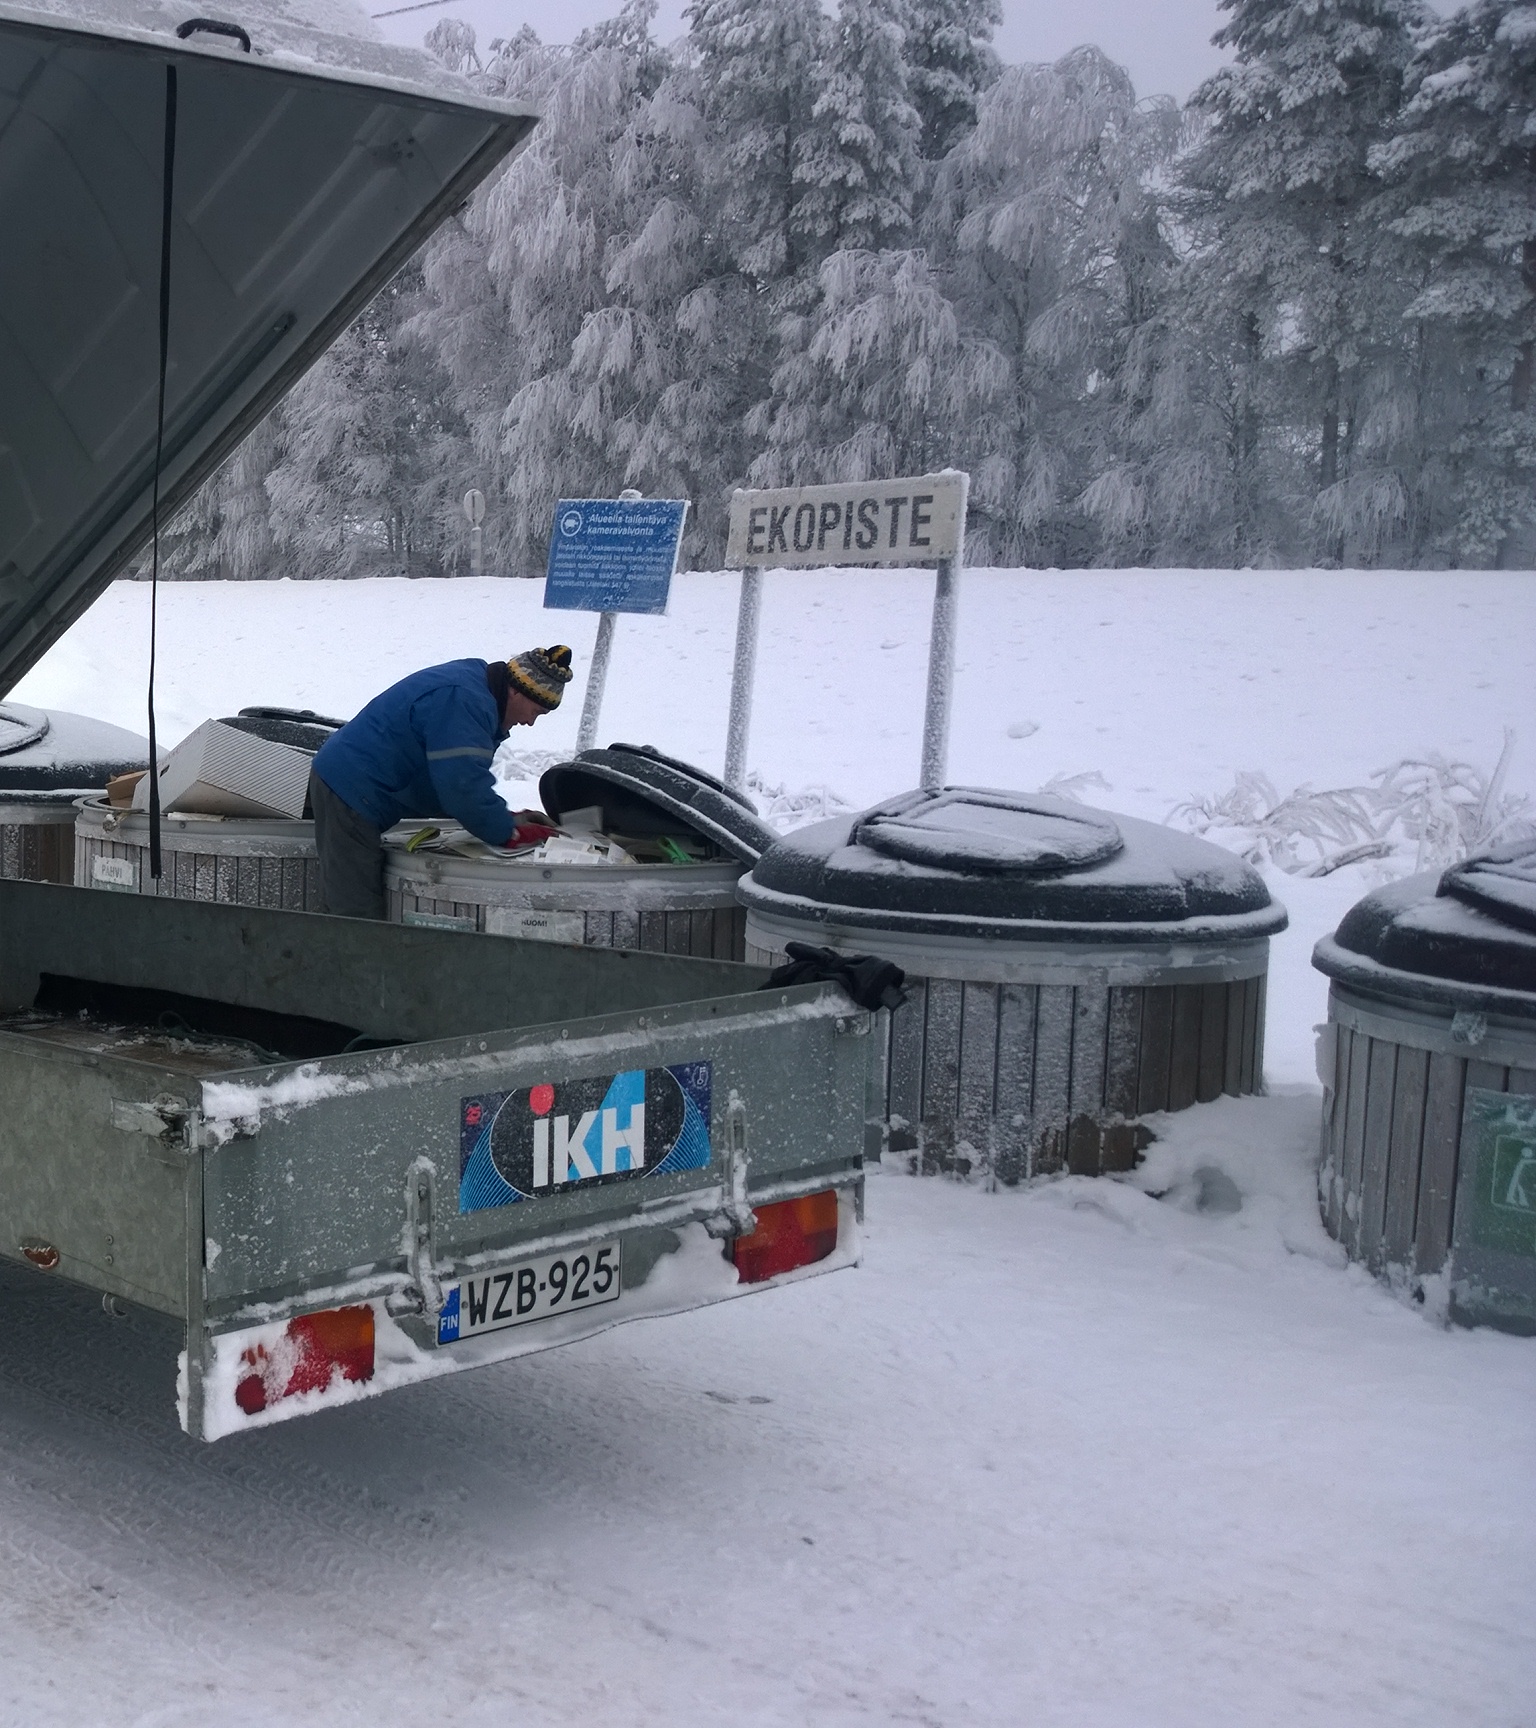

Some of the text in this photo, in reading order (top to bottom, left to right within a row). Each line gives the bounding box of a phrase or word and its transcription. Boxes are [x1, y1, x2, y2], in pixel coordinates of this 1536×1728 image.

[746, 494, 934, 554] EKOPISTE
[467, 1247, 613, 1327] WZB-925
[440, 1313, 459, 1332] FIN
